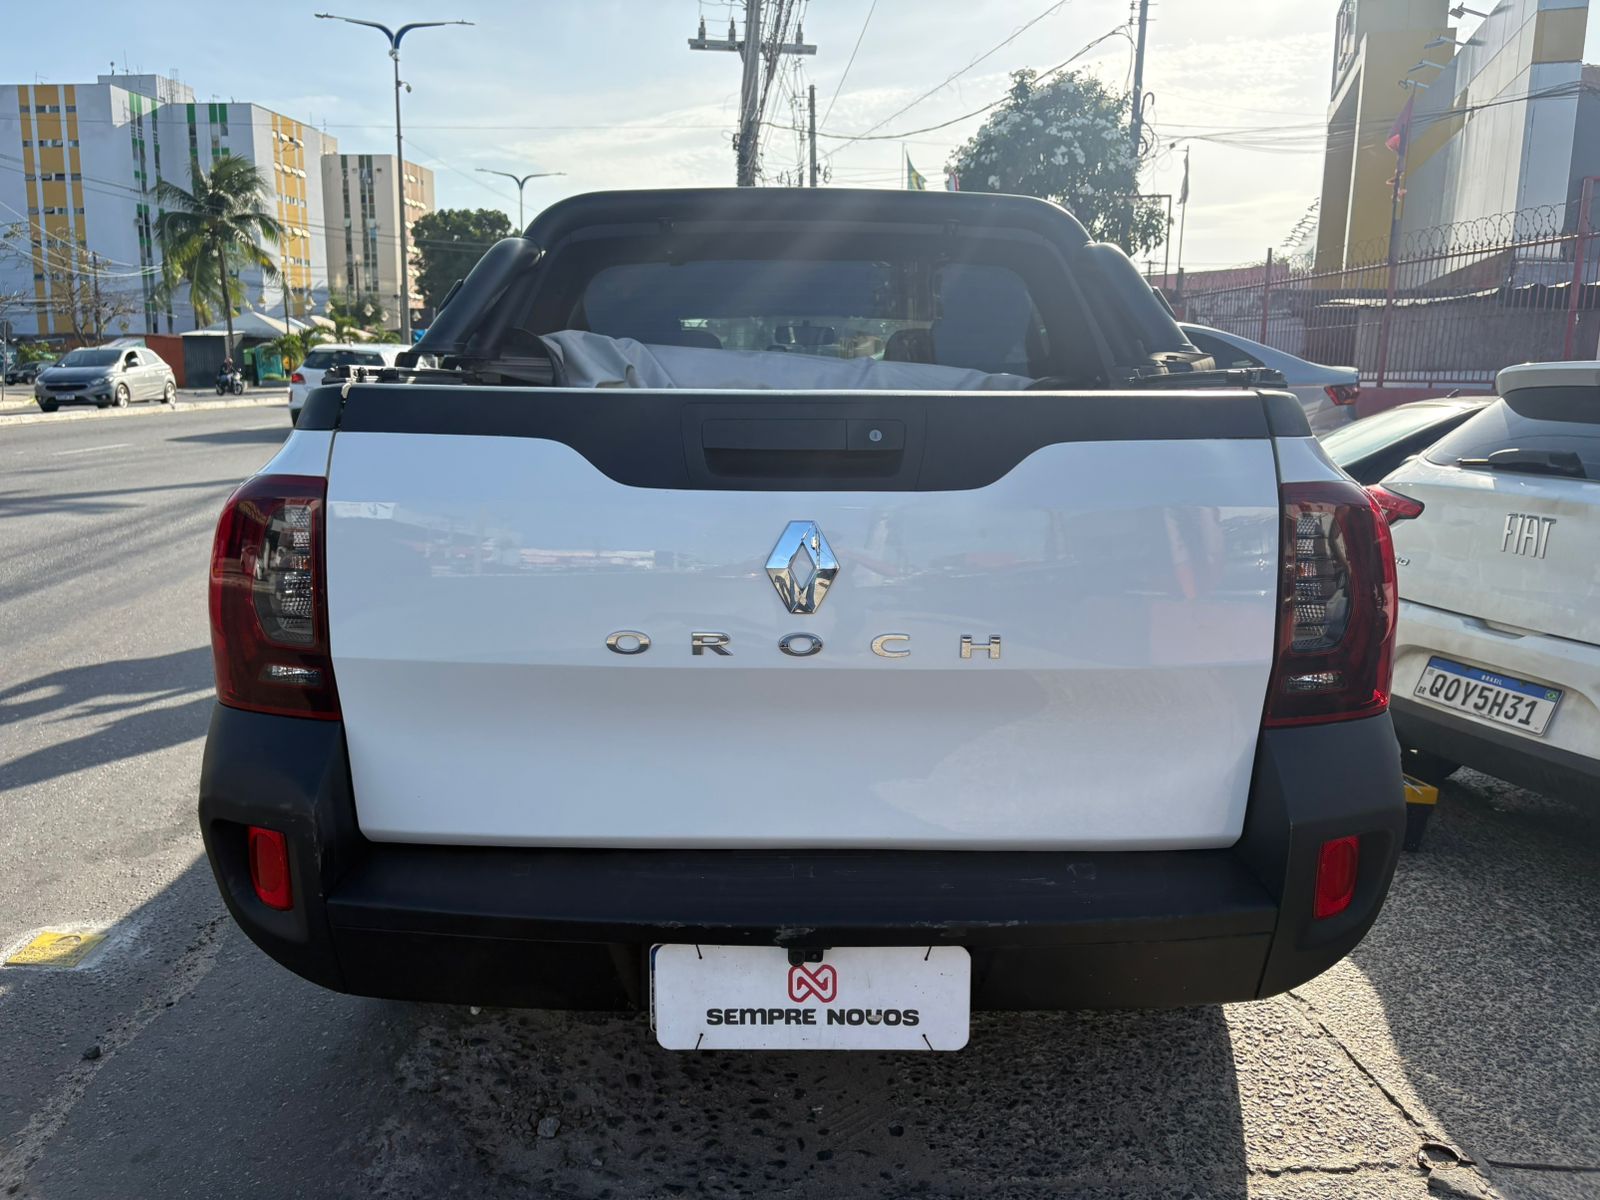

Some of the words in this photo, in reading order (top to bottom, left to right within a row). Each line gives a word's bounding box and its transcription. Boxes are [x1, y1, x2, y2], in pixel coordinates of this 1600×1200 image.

[1500, 513, 1557, 560] FIAT
[606, 630, 1001, 659] OROCH
[1429, 673, 1538, 726] QOY5H31
[706, 1008, 817, 1026] SEMPRE
